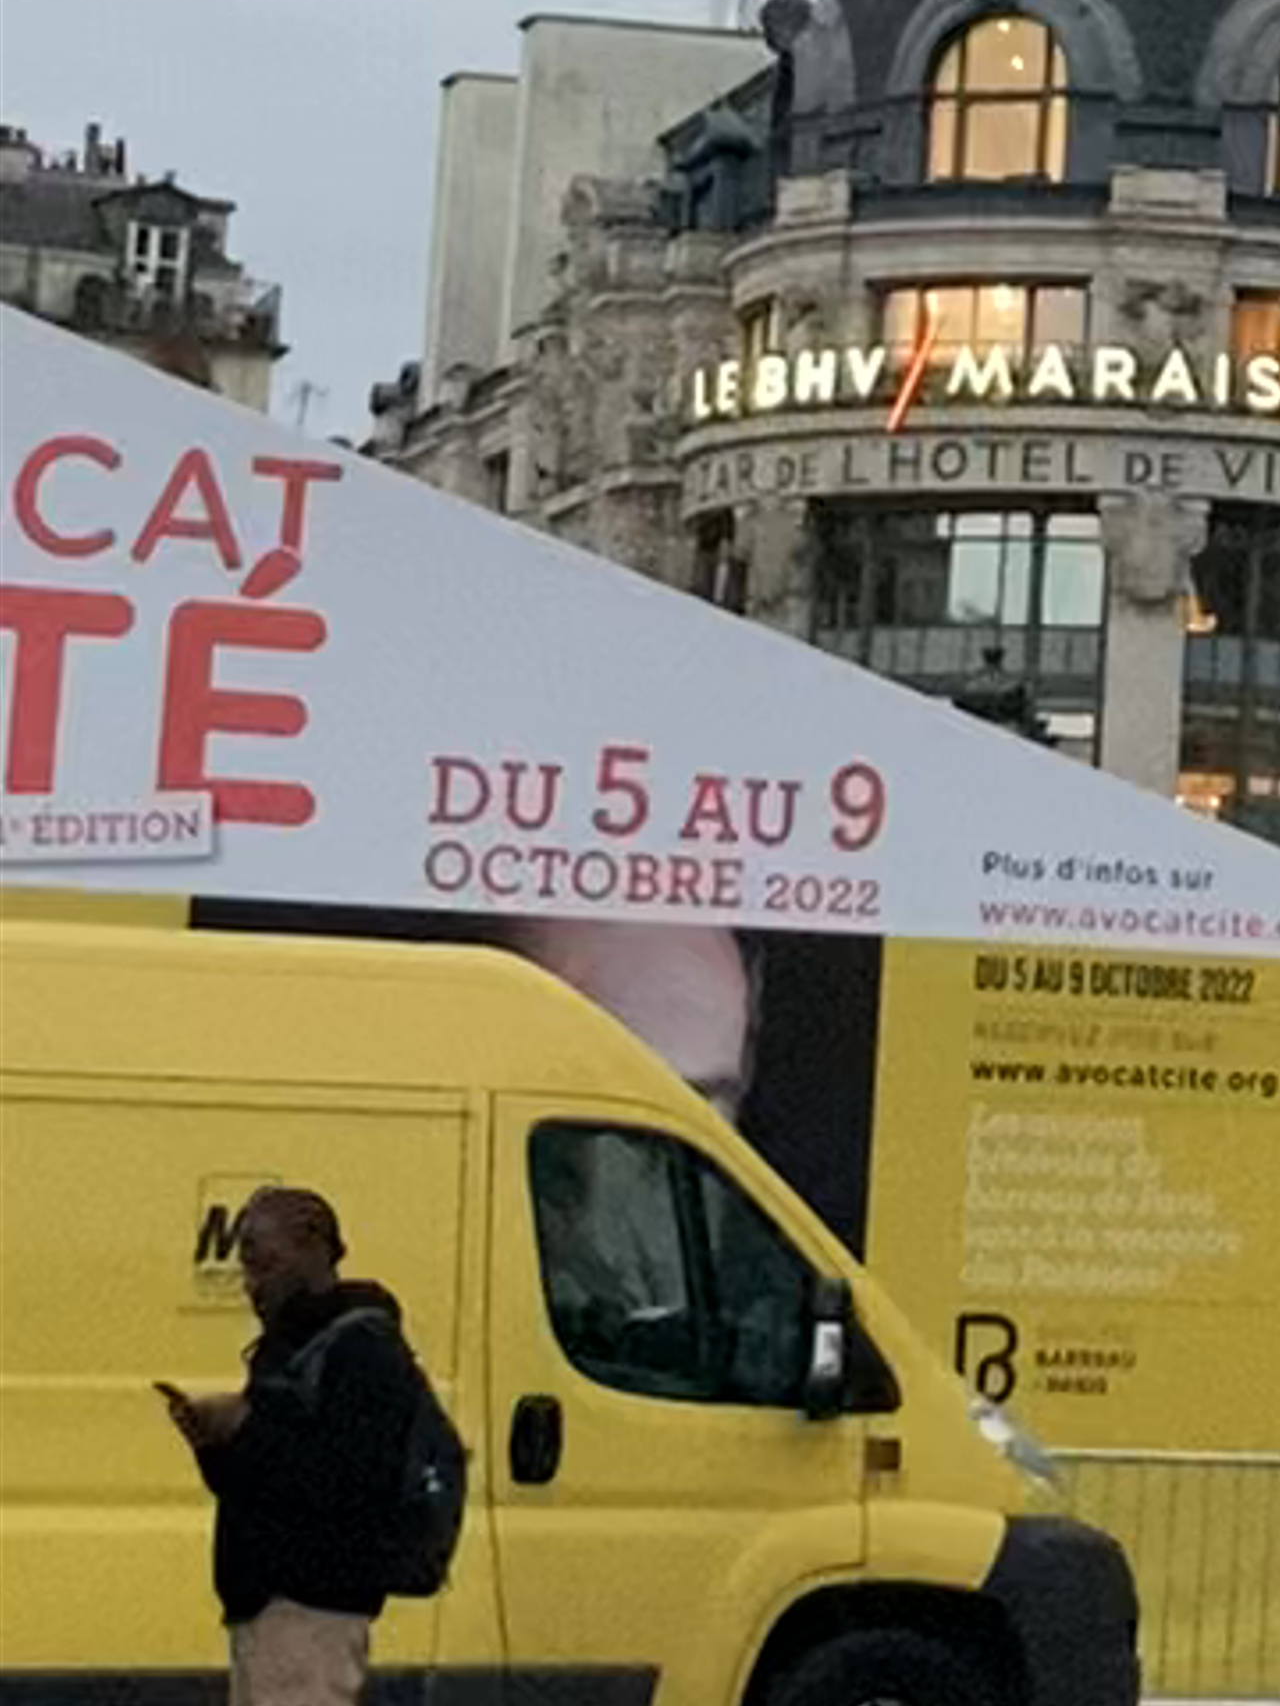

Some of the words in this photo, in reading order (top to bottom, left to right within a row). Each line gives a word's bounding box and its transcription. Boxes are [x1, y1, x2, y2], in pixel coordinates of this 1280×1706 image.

[694, 362, 740, 419] LE
[755, 345, 887, 410] BHV
[13, 434, 345, 572] CAT
[774, 452, 820, 490] DE
[1124, 451, 1185, 487] DE
[428, 755, 564, 832] DU
[591, 745, 651, 838] 5
[680, 773, 804, 849] AU
[830, 761, 887, 854] 9
[424, 839, 745, 909] OCTOBRE
[764, 871, 881, 918] 2022
[982, 850, 1045, 880] Plus
[1055, 857, 1159, 887] d'infos
[1170, 869, 1214, 890] sur
[974, 953, 1009, 992] DU
[1033, 958, 1064, 995] AU
[1090, 962, 1194, 1002] OCTOBRE
